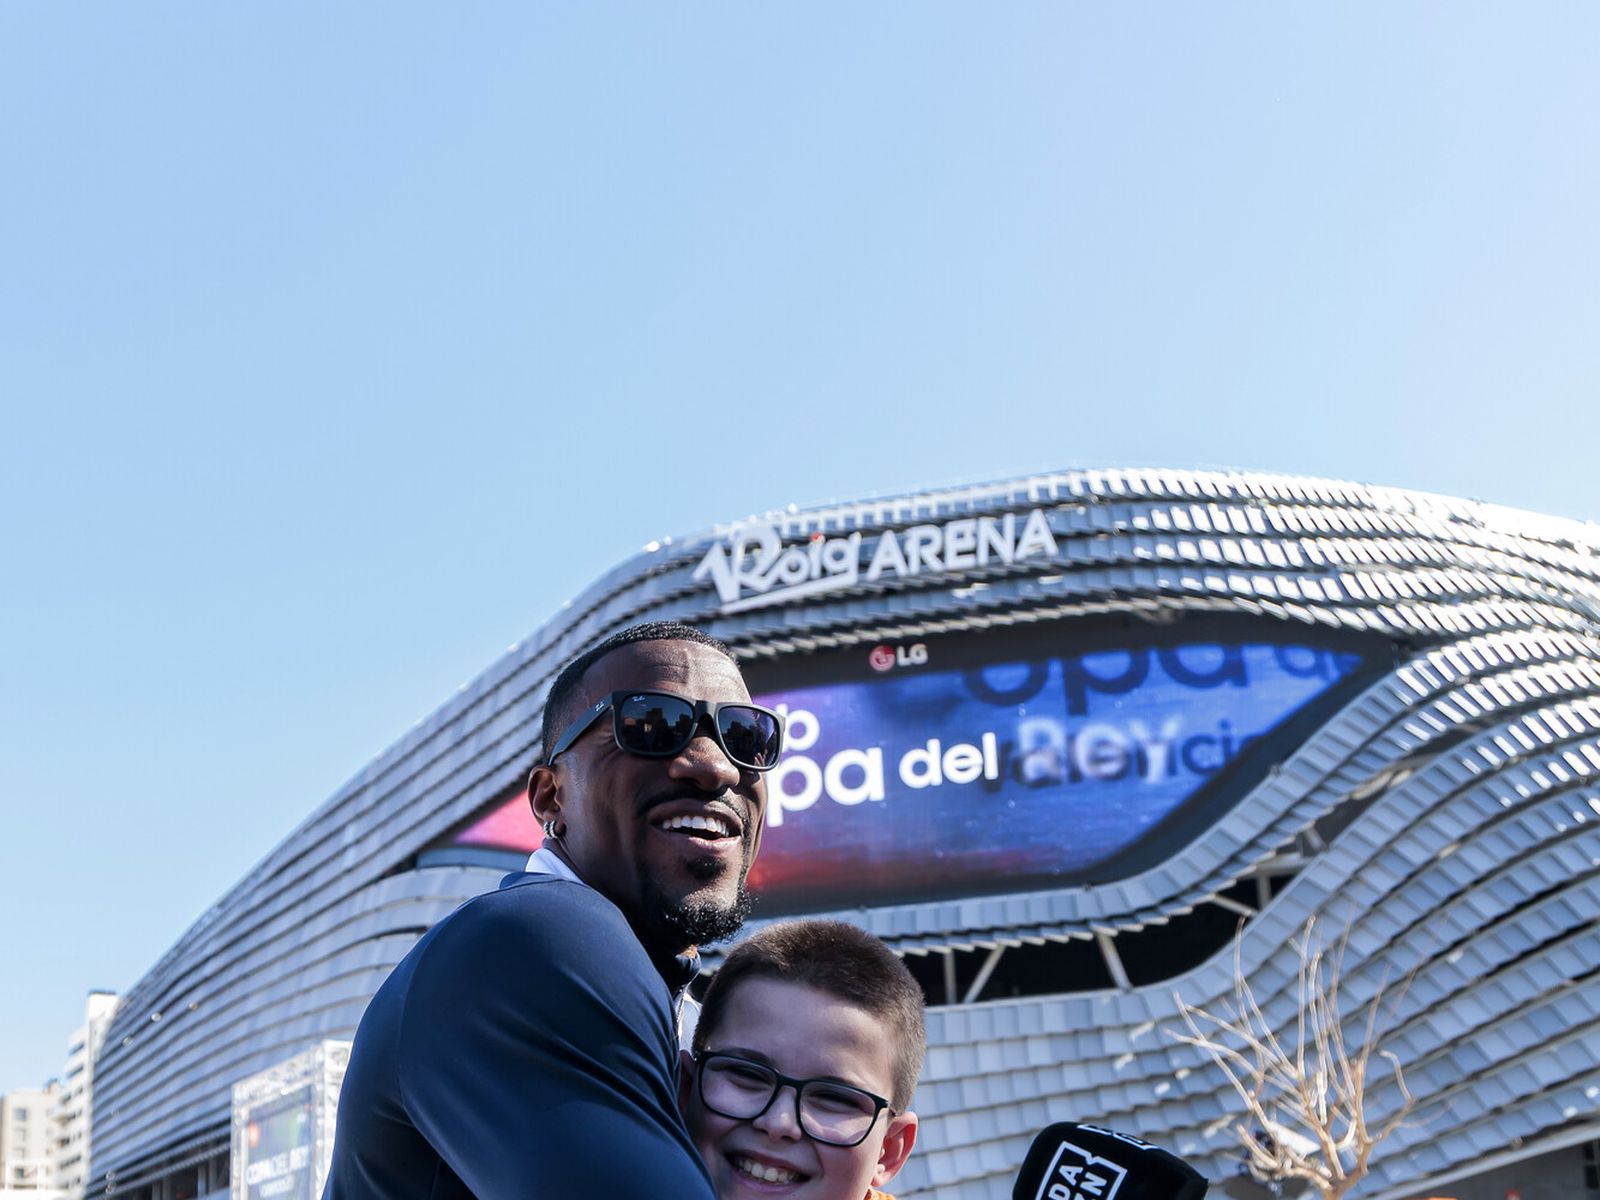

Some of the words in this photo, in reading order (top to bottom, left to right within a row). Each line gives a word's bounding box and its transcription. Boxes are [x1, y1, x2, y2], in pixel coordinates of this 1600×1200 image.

[693, 527, 862, 613] Roig
[867, 509, 1058, 579] ARENA
[896, 643, 928, 667] LG
[766, 747, 885, 827] pa
[899, 731, 998, 789] del
